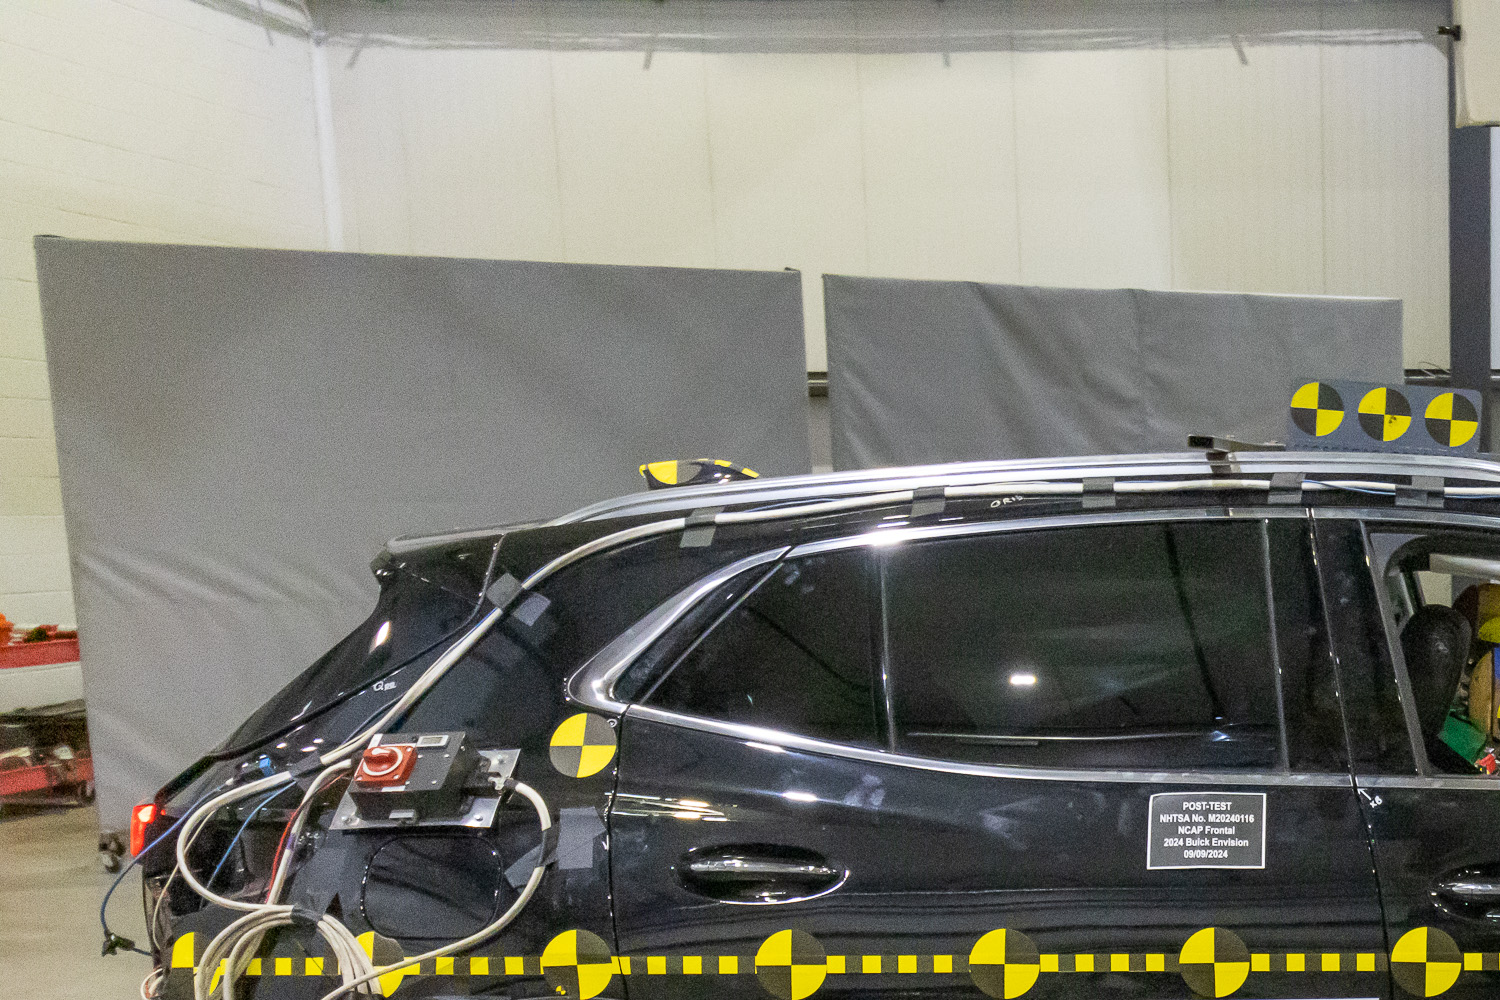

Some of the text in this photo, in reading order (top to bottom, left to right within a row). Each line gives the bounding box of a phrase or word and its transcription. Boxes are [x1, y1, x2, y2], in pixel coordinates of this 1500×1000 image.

[1182, 801, 1232, 811] POST-TEST
[1160, 814, 1254, 823] NHTSA No. M20240116
[1178, 825, 1235, 834] NCAP Frontal
[1163, 838, 1249, 847] 2024 Buick Envision
[1183, 849, 1228, 859] 09/09/2024
